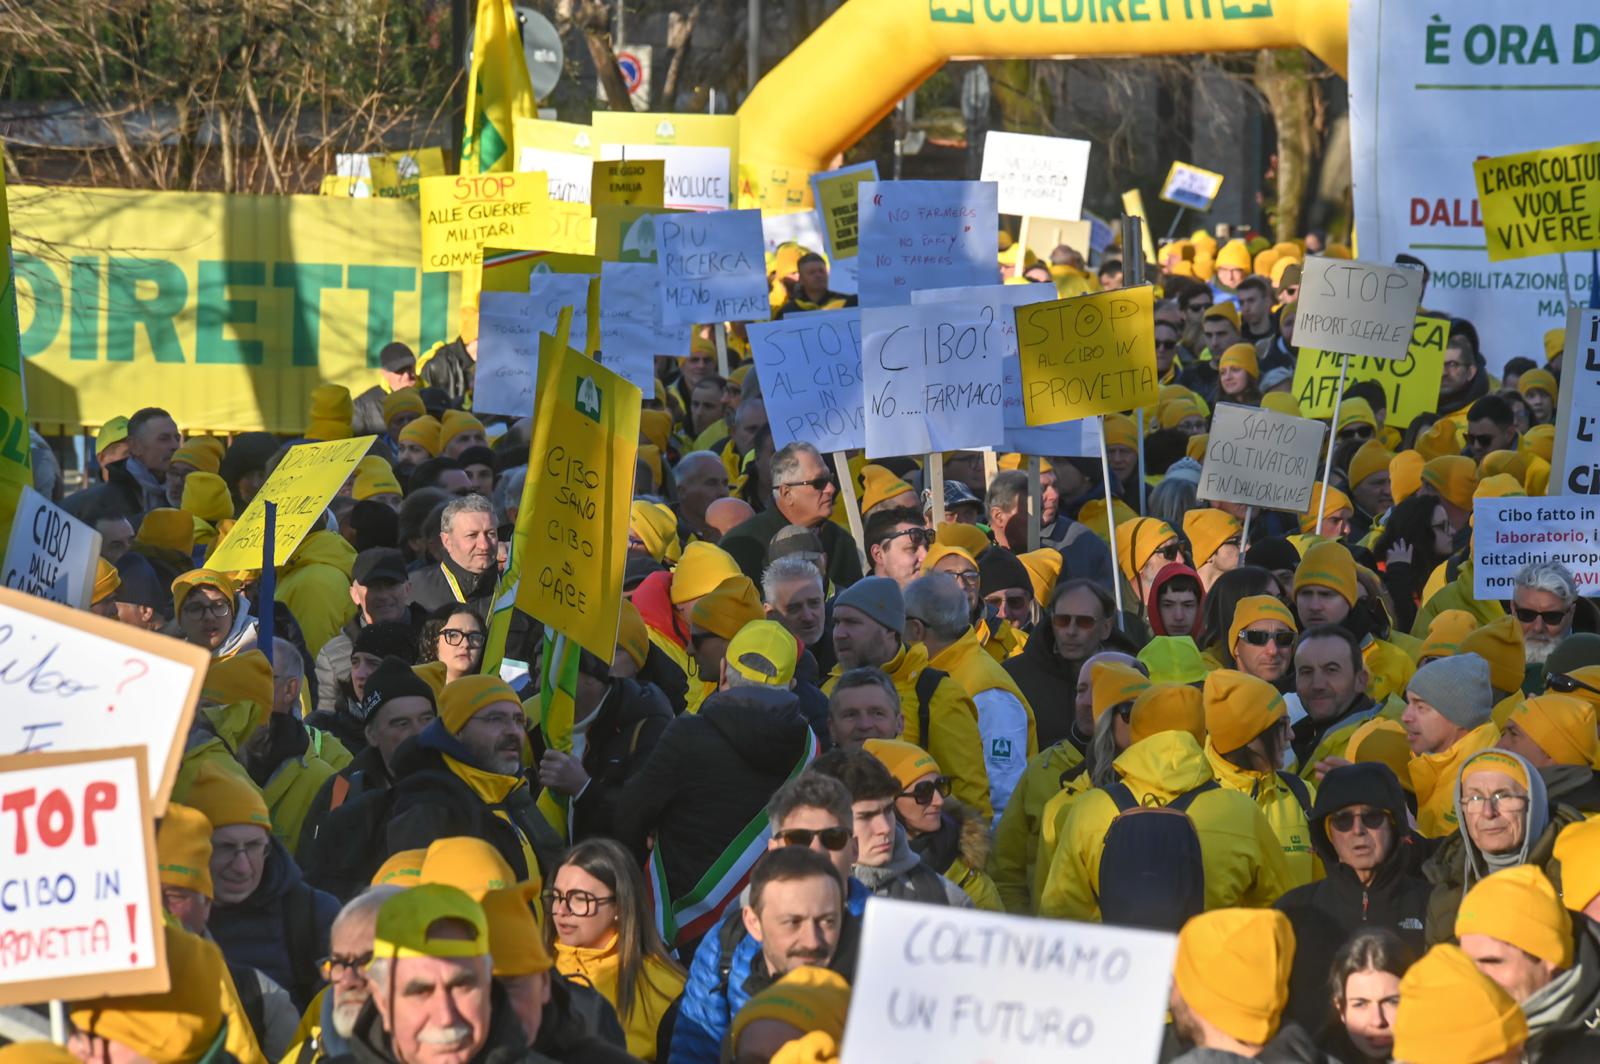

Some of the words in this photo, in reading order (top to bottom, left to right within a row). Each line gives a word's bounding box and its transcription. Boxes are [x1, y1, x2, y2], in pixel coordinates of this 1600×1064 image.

[1424, 13, 1451, 64] È
[1463, 23, 1560, 65] ORA
[453, 176, 515, 200] STOP
[609, 183, 642, 192] EMILIA
[1483, 152, 1600, 195] L'AGRICOLTU
[428, 207, 463, 225] ALLE
[468, 201, 532, 219] GUERRE
[888, 210, 909, 224] NO
[918, 207, 977, 221] FARMERS
[1513, 184, 1586, 218] VUOLE
[446, 222, 514, 242] MILITARI
[665, 251, 751, 276] RICERCA
[876, 255, 892, 268] NO
[666, 286, 710, 308] MENO
[1320, 264, 1409, 305] STOP
[1432, 271, 1568, 291] MOBILITAZIONE
[880, 305, 994, 371] CIBO?
[1024, 299, 1139, 347] STOP
[1301, 313, 1347, 337] IMPORT
[1346, 319, 1406, 343] SLEALE
[1038, 352, 1058, 368] AL
[1063, 345, 1104, 364] CIBO
[1116, 335, 1138, 357] IN
[770, 371, 807, 399] AL
[818, 389, 837, 409] IN
[925, 382, 1001, 414] FARMACO
[1029, 366, 1153, 413] PROVETTA
[1235, 414, 1297, 445] SIAMO
[547, 446, 600, 489] CIBO
[1209, 440, 1308, 478] COLTIVATORI
[1207, 473, 1232, 493] FIN
[554, 486, 597, 520] SANO
[1498, 508, 1533, 522] Cibo
[1537, 507, 1576, 521] fatto
[1580, 506, 1595, 520] in
[33, 505, 71, 563] CIBO
[547, 519, 594, 558] CIBO
[1496, 529, 1588, 544] laboratorio,
[29, 552, 59, 589] DALLE
[1481, 551, 1547, 566] cittadini
[1552, 552, 1600, 567] europ
[538, 566, 587, 615] PACE
[1, 873, 77, 912] CIBO
[95, 869, 121, 900] IN
[887, 987, 938, 1032] UN
[952, 993, 1095, 1048] FUTURO
